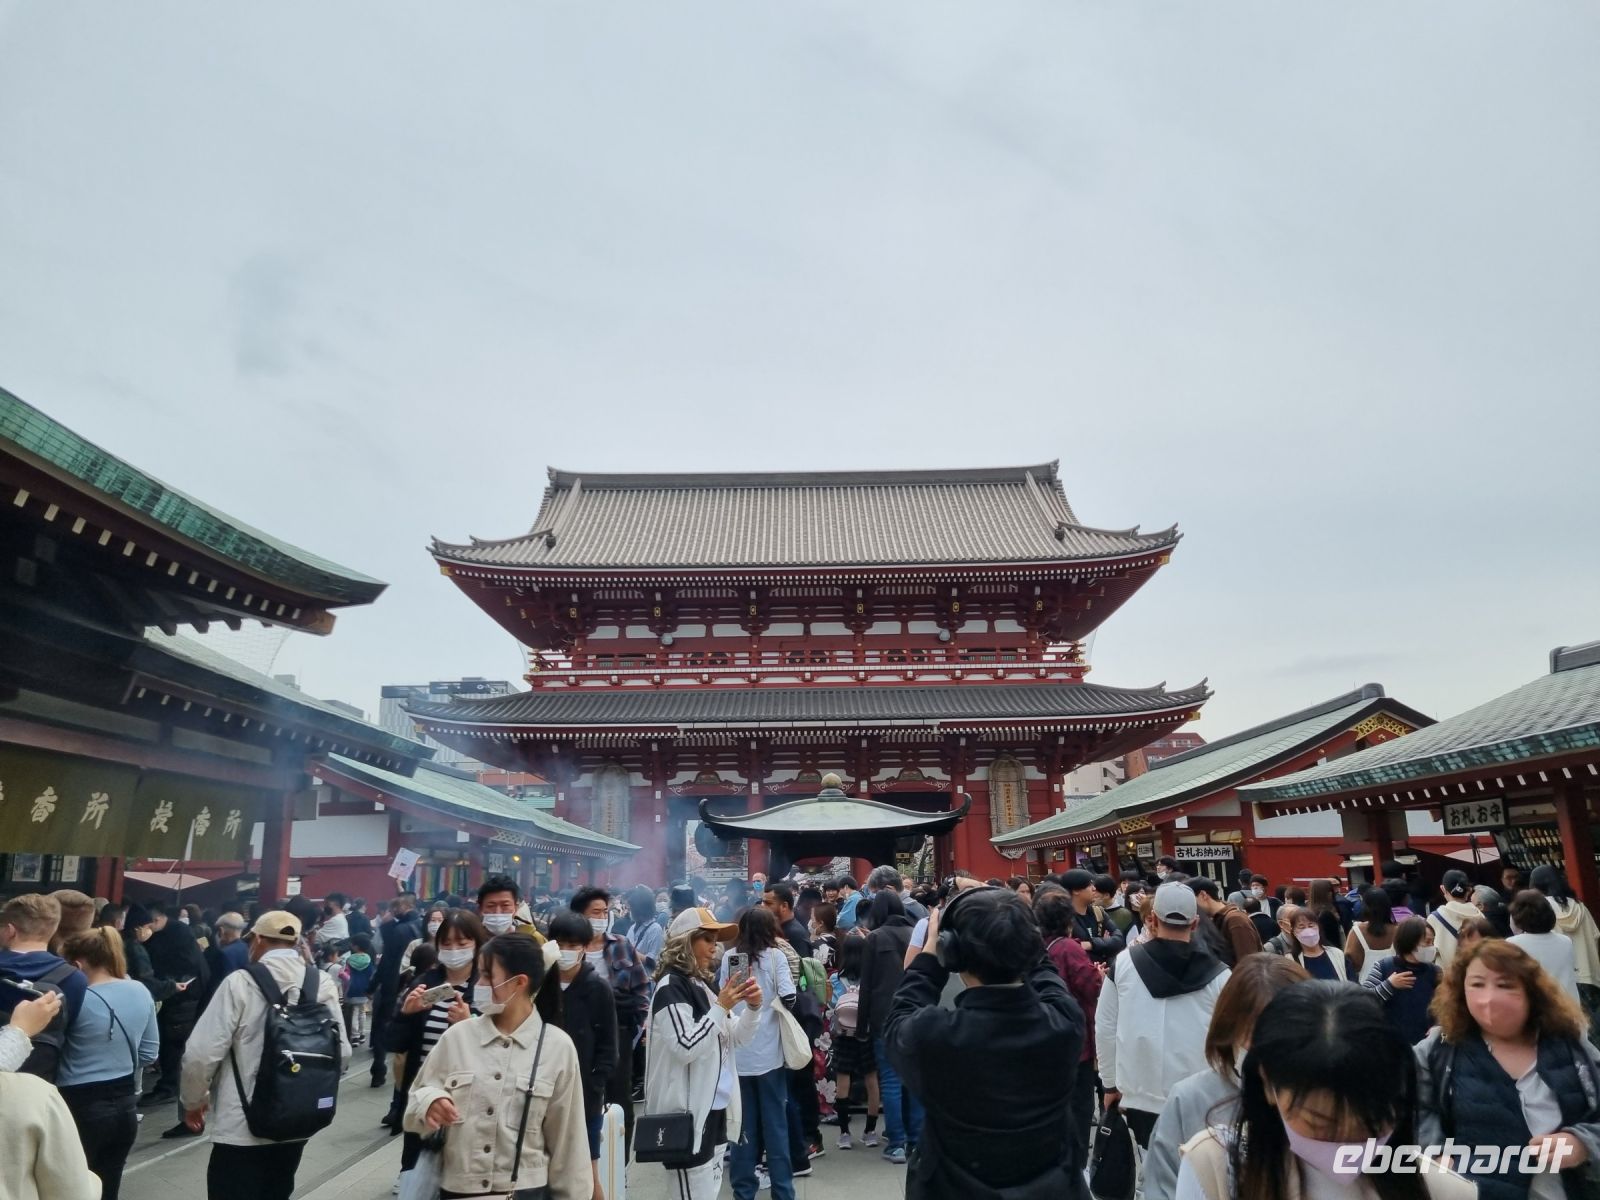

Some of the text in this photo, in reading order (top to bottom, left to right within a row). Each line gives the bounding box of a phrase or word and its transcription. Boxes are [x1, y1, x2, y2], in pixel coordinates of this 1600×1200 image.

[0, 781, 109, 830] 香所
[150, 799, 243, 840] 授香所
[1449, 801, 1502, 827] お札お守
[1176, 846, 1231, 859] 古札お納め所
